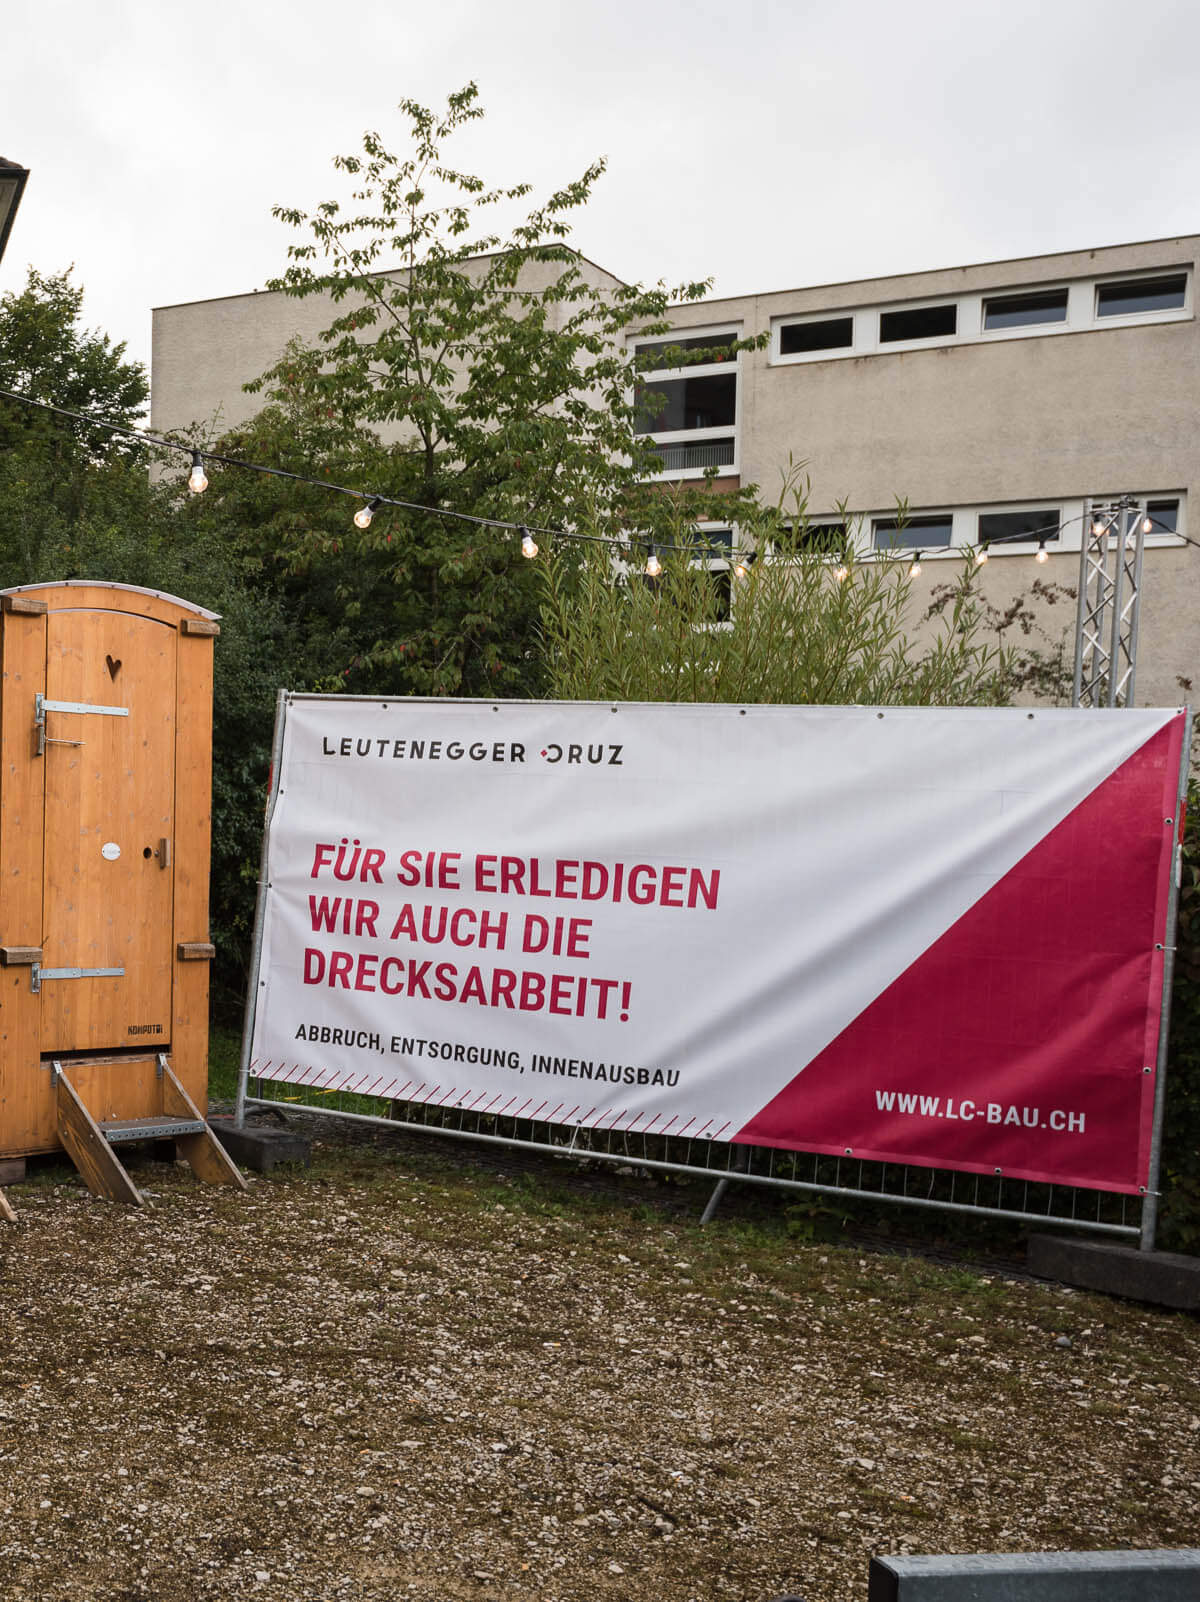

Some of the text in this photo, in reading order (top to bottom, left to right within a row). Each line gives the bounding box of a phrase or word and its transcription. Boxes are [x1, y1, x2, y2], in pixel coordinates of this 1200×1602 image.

[323, 737, 526, 763] LEUTENEGGER
[311, 837, 721, 910] FÜR SIE ERLEDIGEN
[309, 895, 593, 959] WIR AUCH DIE
[303, 947, 632, 1022] DRECKSARBEIT!
[295, 1023, 680, 1087] ABBRUCH, ENTSORGUNG, INNENAUSBAU
[875, 1090, 1086, 1134] WWW.LC-BAU.CH
